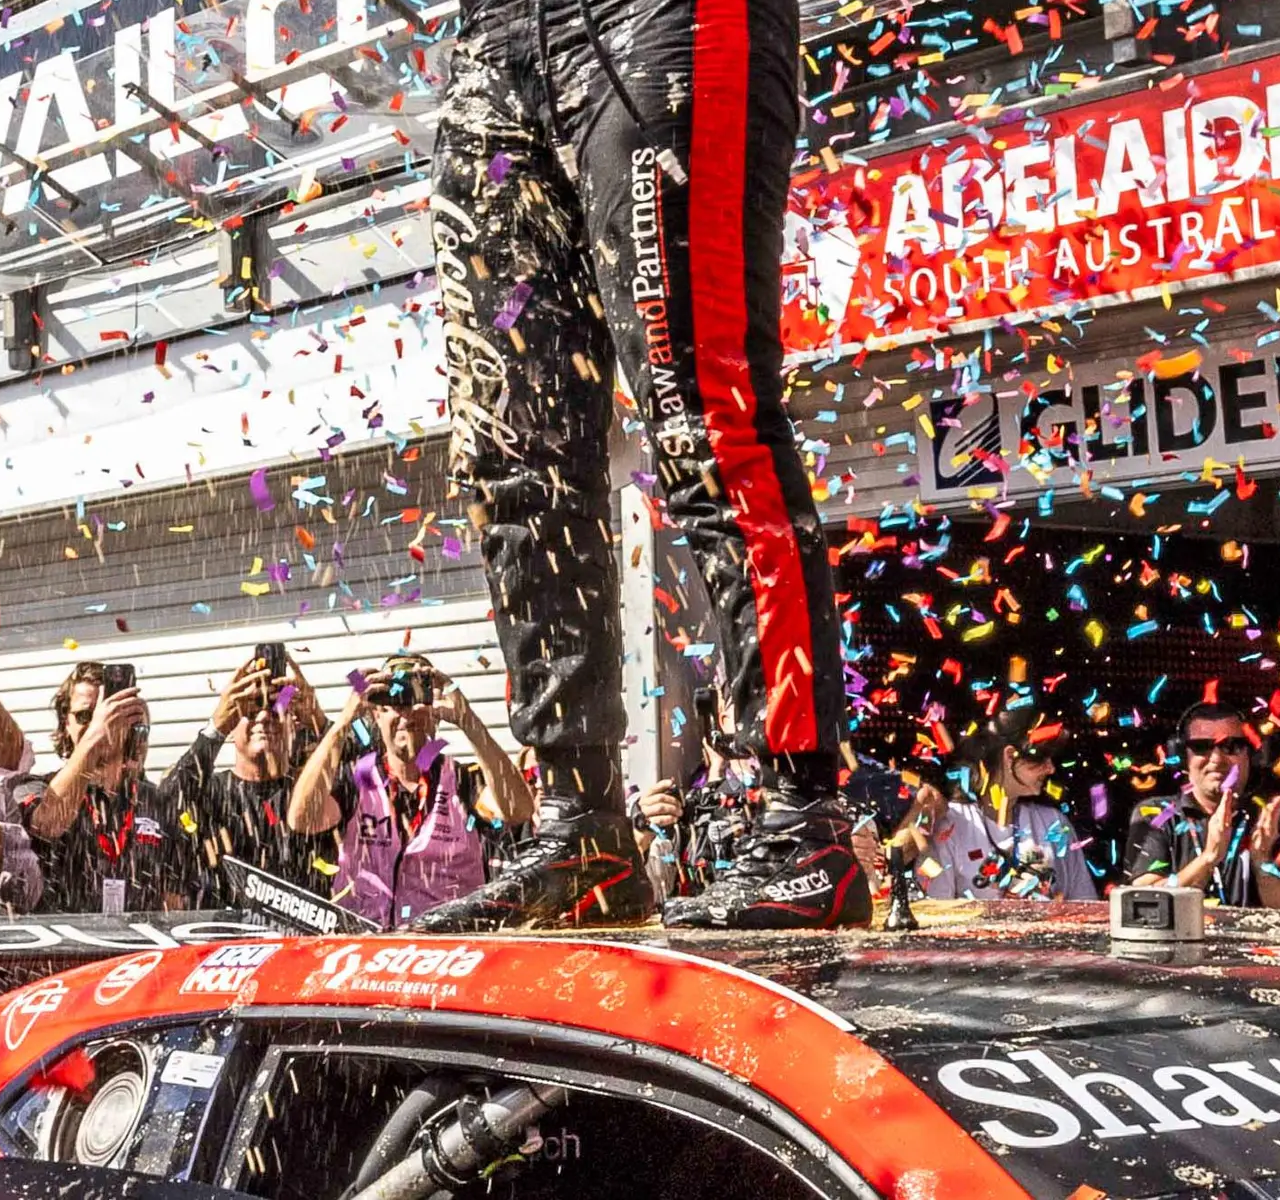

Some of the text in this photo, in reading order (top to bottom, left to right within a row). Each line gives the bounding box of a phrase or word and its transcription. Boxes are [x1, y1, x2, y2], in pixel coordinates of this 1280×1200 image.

[884, 242, 1030, 313] SOUTH
[764, 867, 832, 902] sparco
[244, 873, 338, 936] SUPERCHEAP
[364, 943, 485, 978] strata
[183, 966, 256, 993] MOLY
[351, 978, 438, 998] MANAGEMENT
